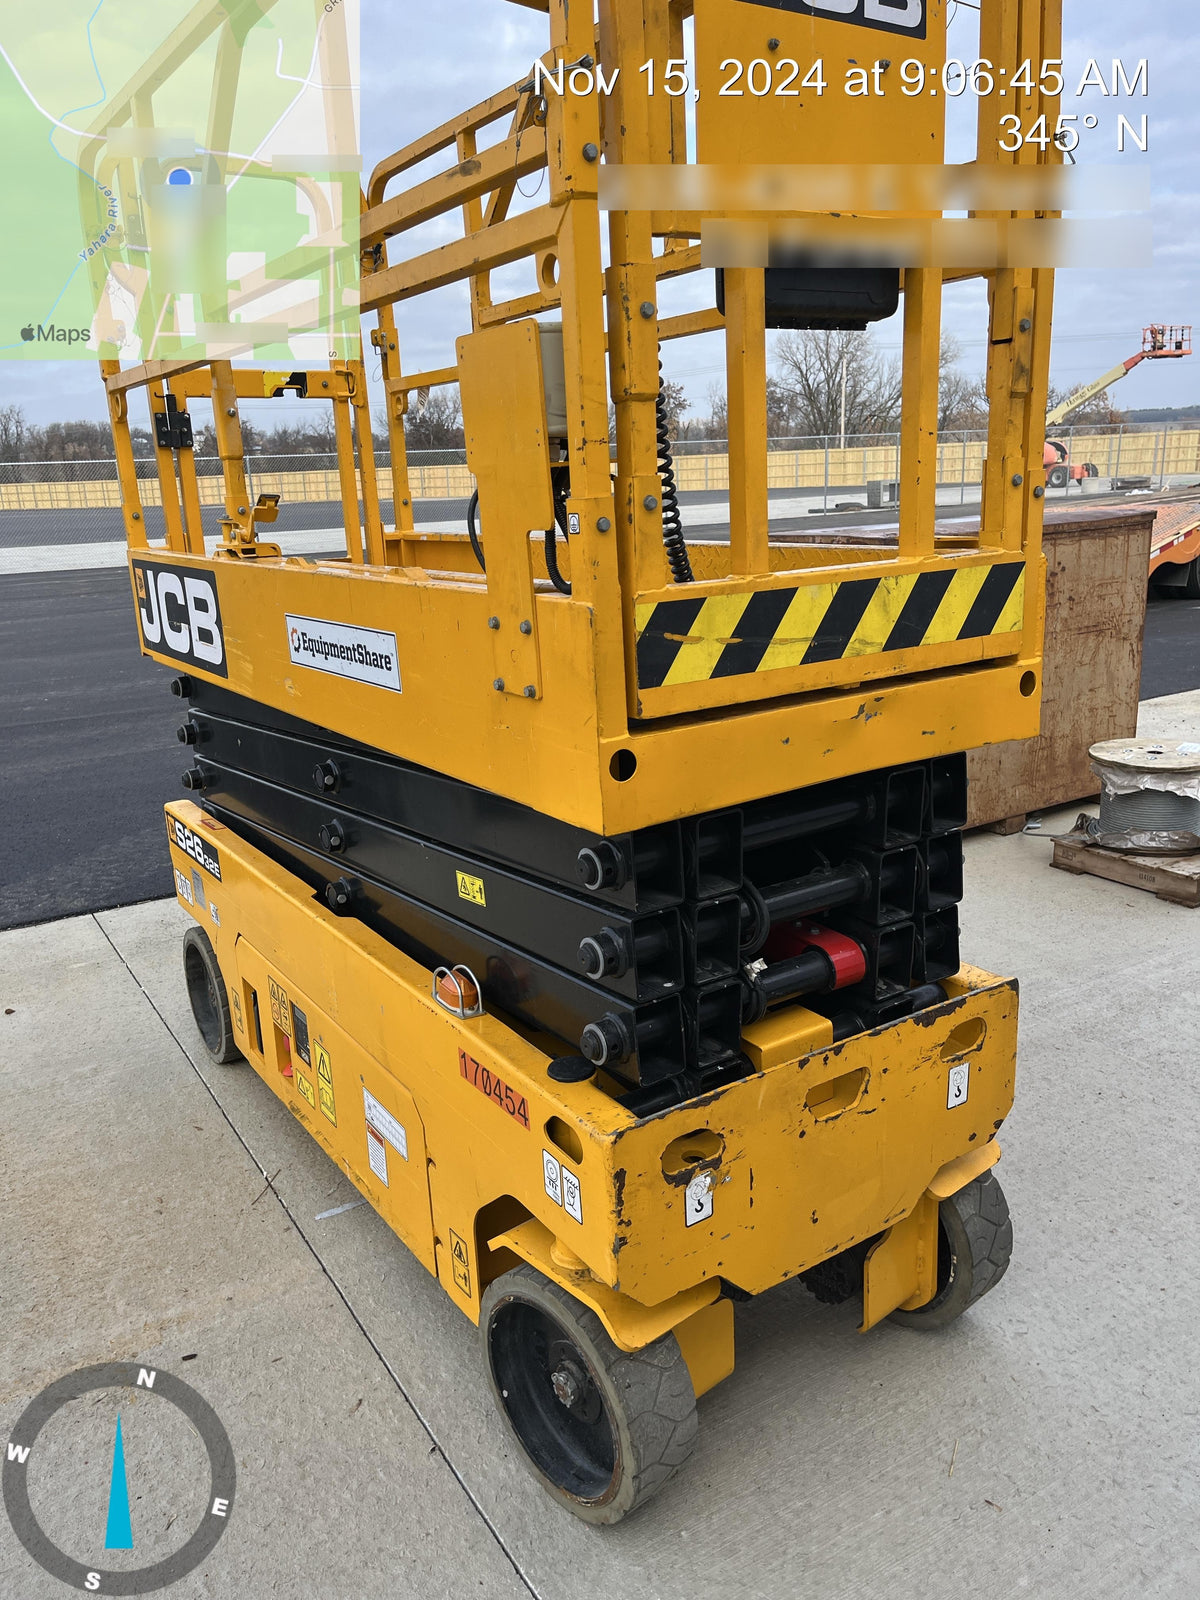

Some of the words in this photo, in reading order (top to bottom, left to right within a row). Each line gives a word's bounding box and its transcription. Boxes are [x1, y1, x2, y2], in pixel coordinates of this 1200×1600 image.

[140, 569, 223, 665] JCB
[300, 631, 393, 672] EquipmentShare
[460, 1051, 529, 1127] 170454
